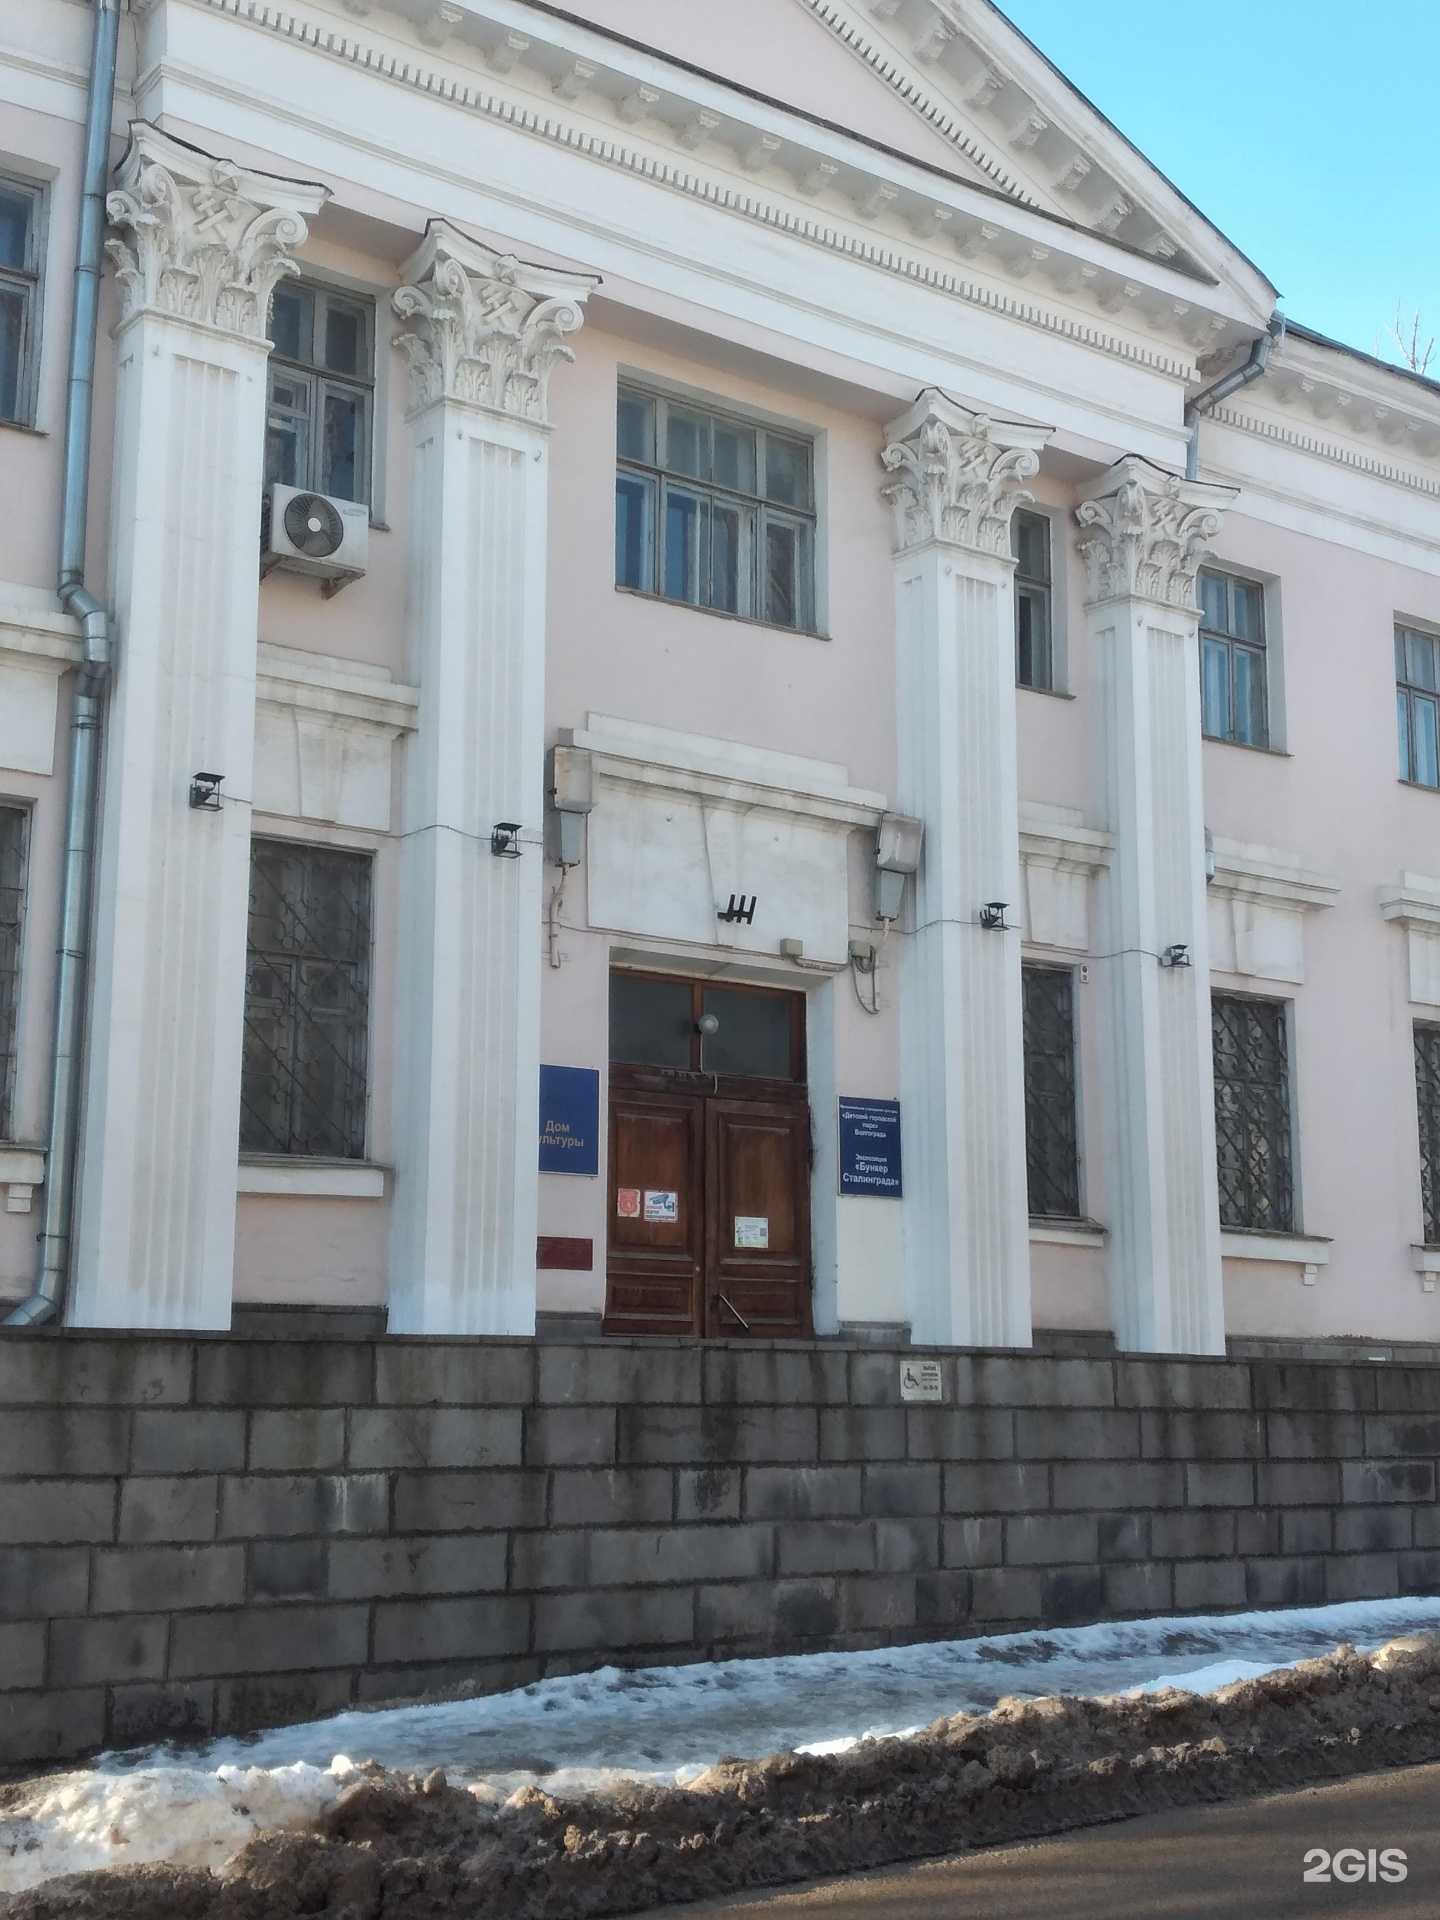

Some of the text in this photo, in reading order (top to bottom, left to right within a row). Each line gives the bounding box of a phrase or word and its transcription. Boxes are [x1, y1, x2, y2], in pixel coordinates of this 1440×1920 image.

[545, 1120, 570, 1134] Дом
[855, 1162, 889, 1175] «Бункер
[843, 1173, 899, 1186] Сталинграда»
